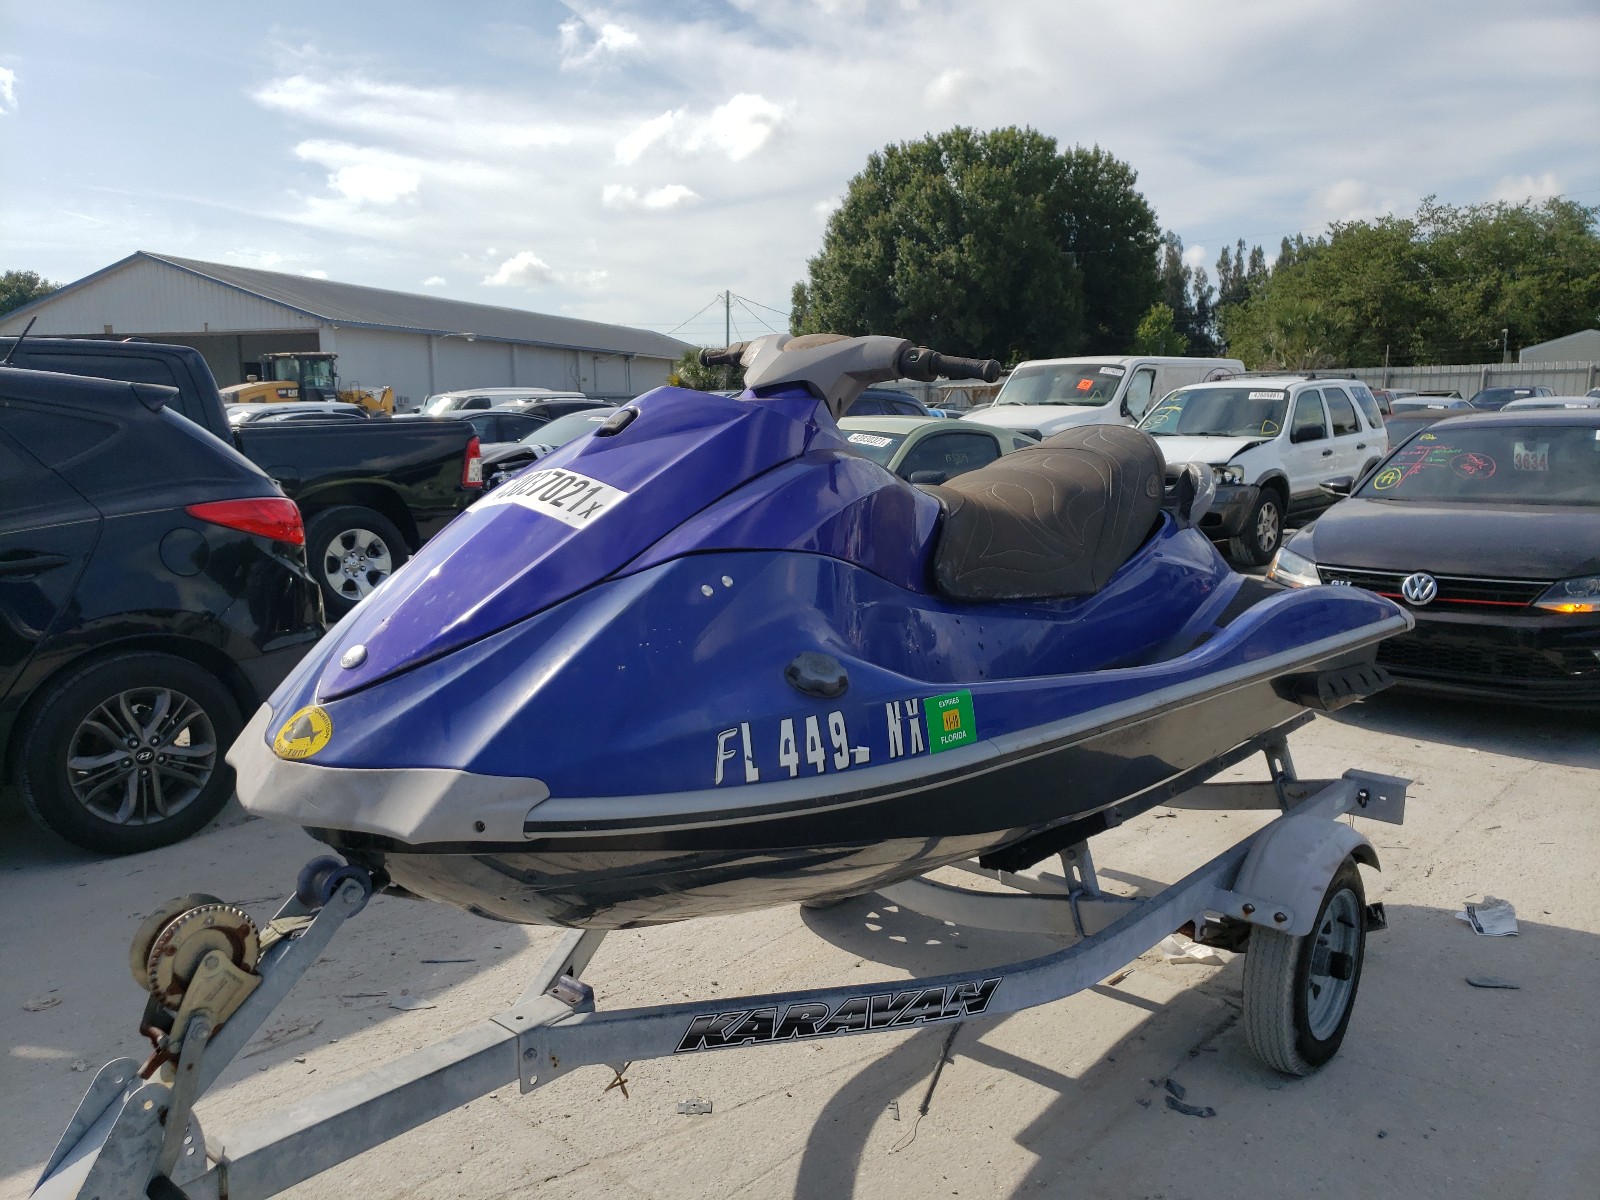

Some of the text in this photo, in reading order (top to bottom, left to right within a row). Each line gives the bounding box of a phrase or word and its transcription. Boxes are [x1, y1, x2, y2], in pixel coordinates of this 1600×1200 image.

[287, 389, 298, 397] CAT
[938, 696, 960, 708] EXPIRES
[940, 730, 967, 745] FLORIDA
[674, 975, 1004, 1053] KARAVAN
